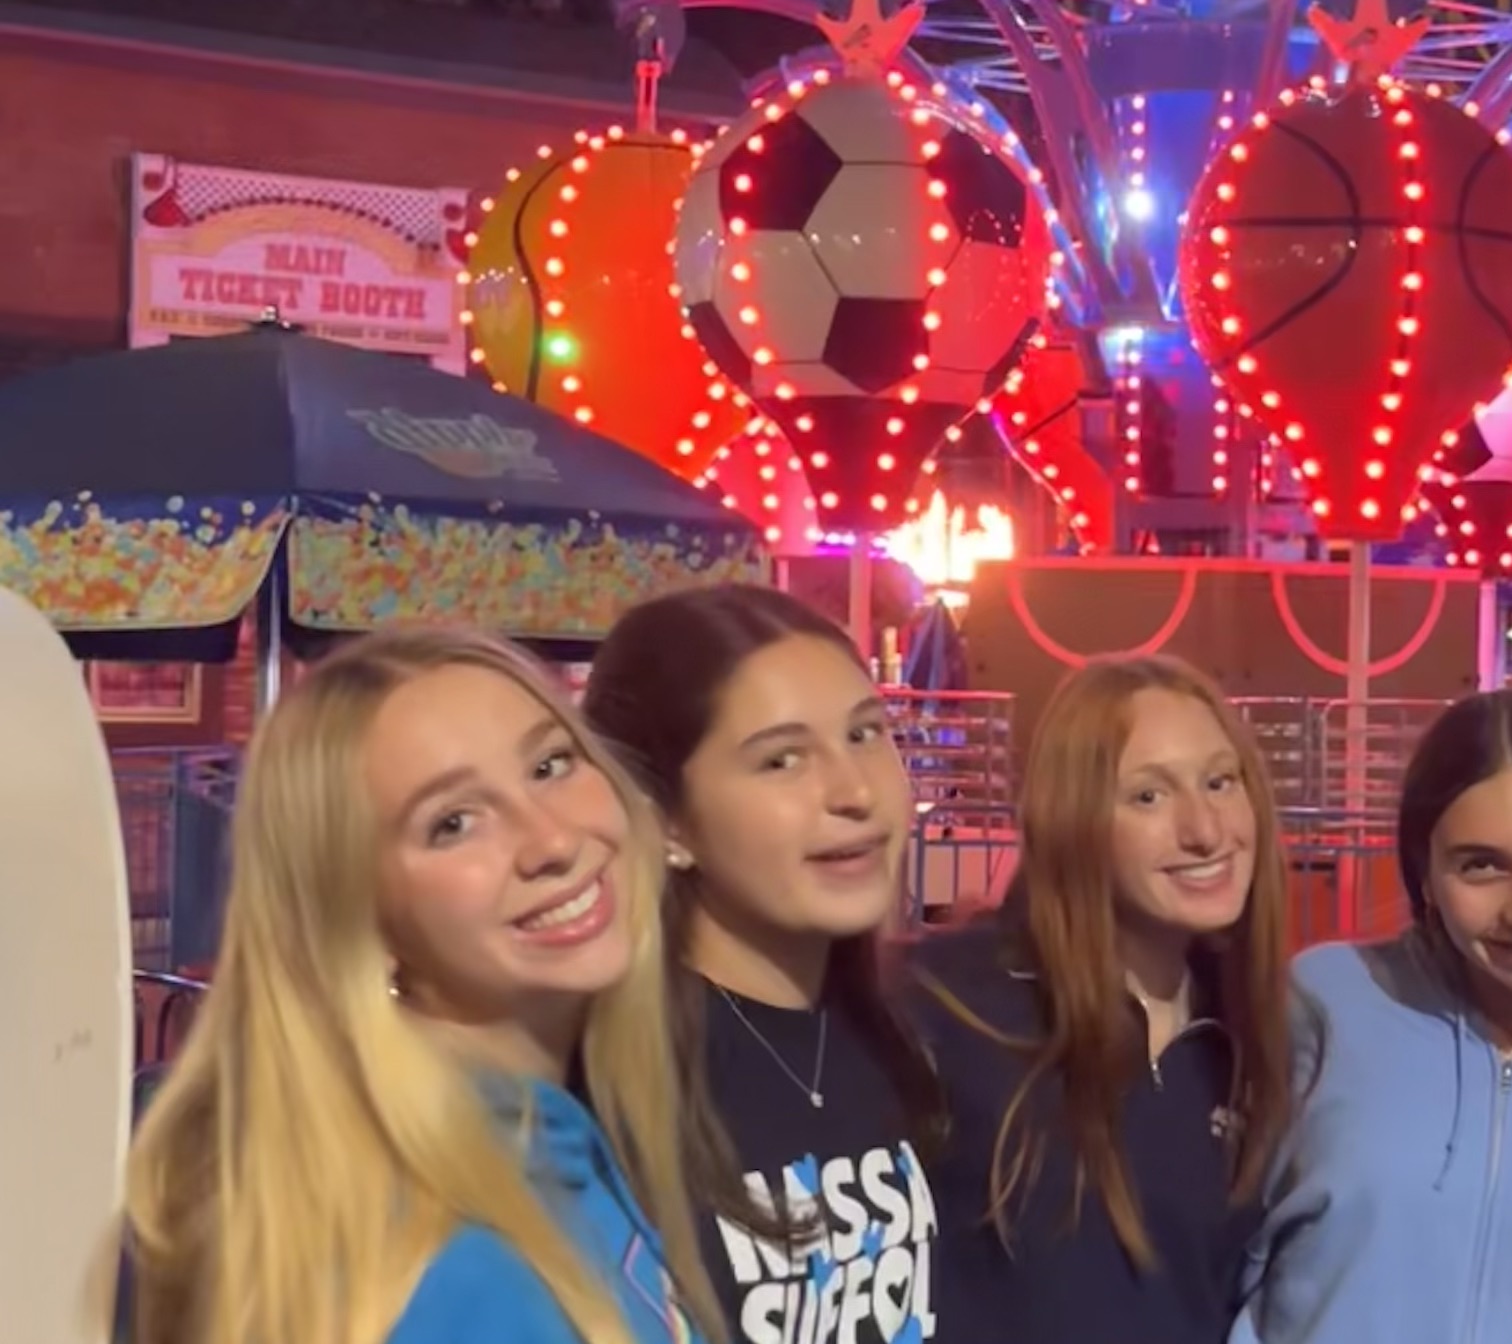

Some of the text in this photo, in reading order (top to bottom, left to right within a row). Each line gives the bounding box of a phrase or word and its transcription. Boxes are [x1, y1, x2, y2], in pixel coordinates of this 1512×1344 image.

[264, 242, 347, 277] MAIN
[179, 268, 426, 319] TICKET BOOTH
